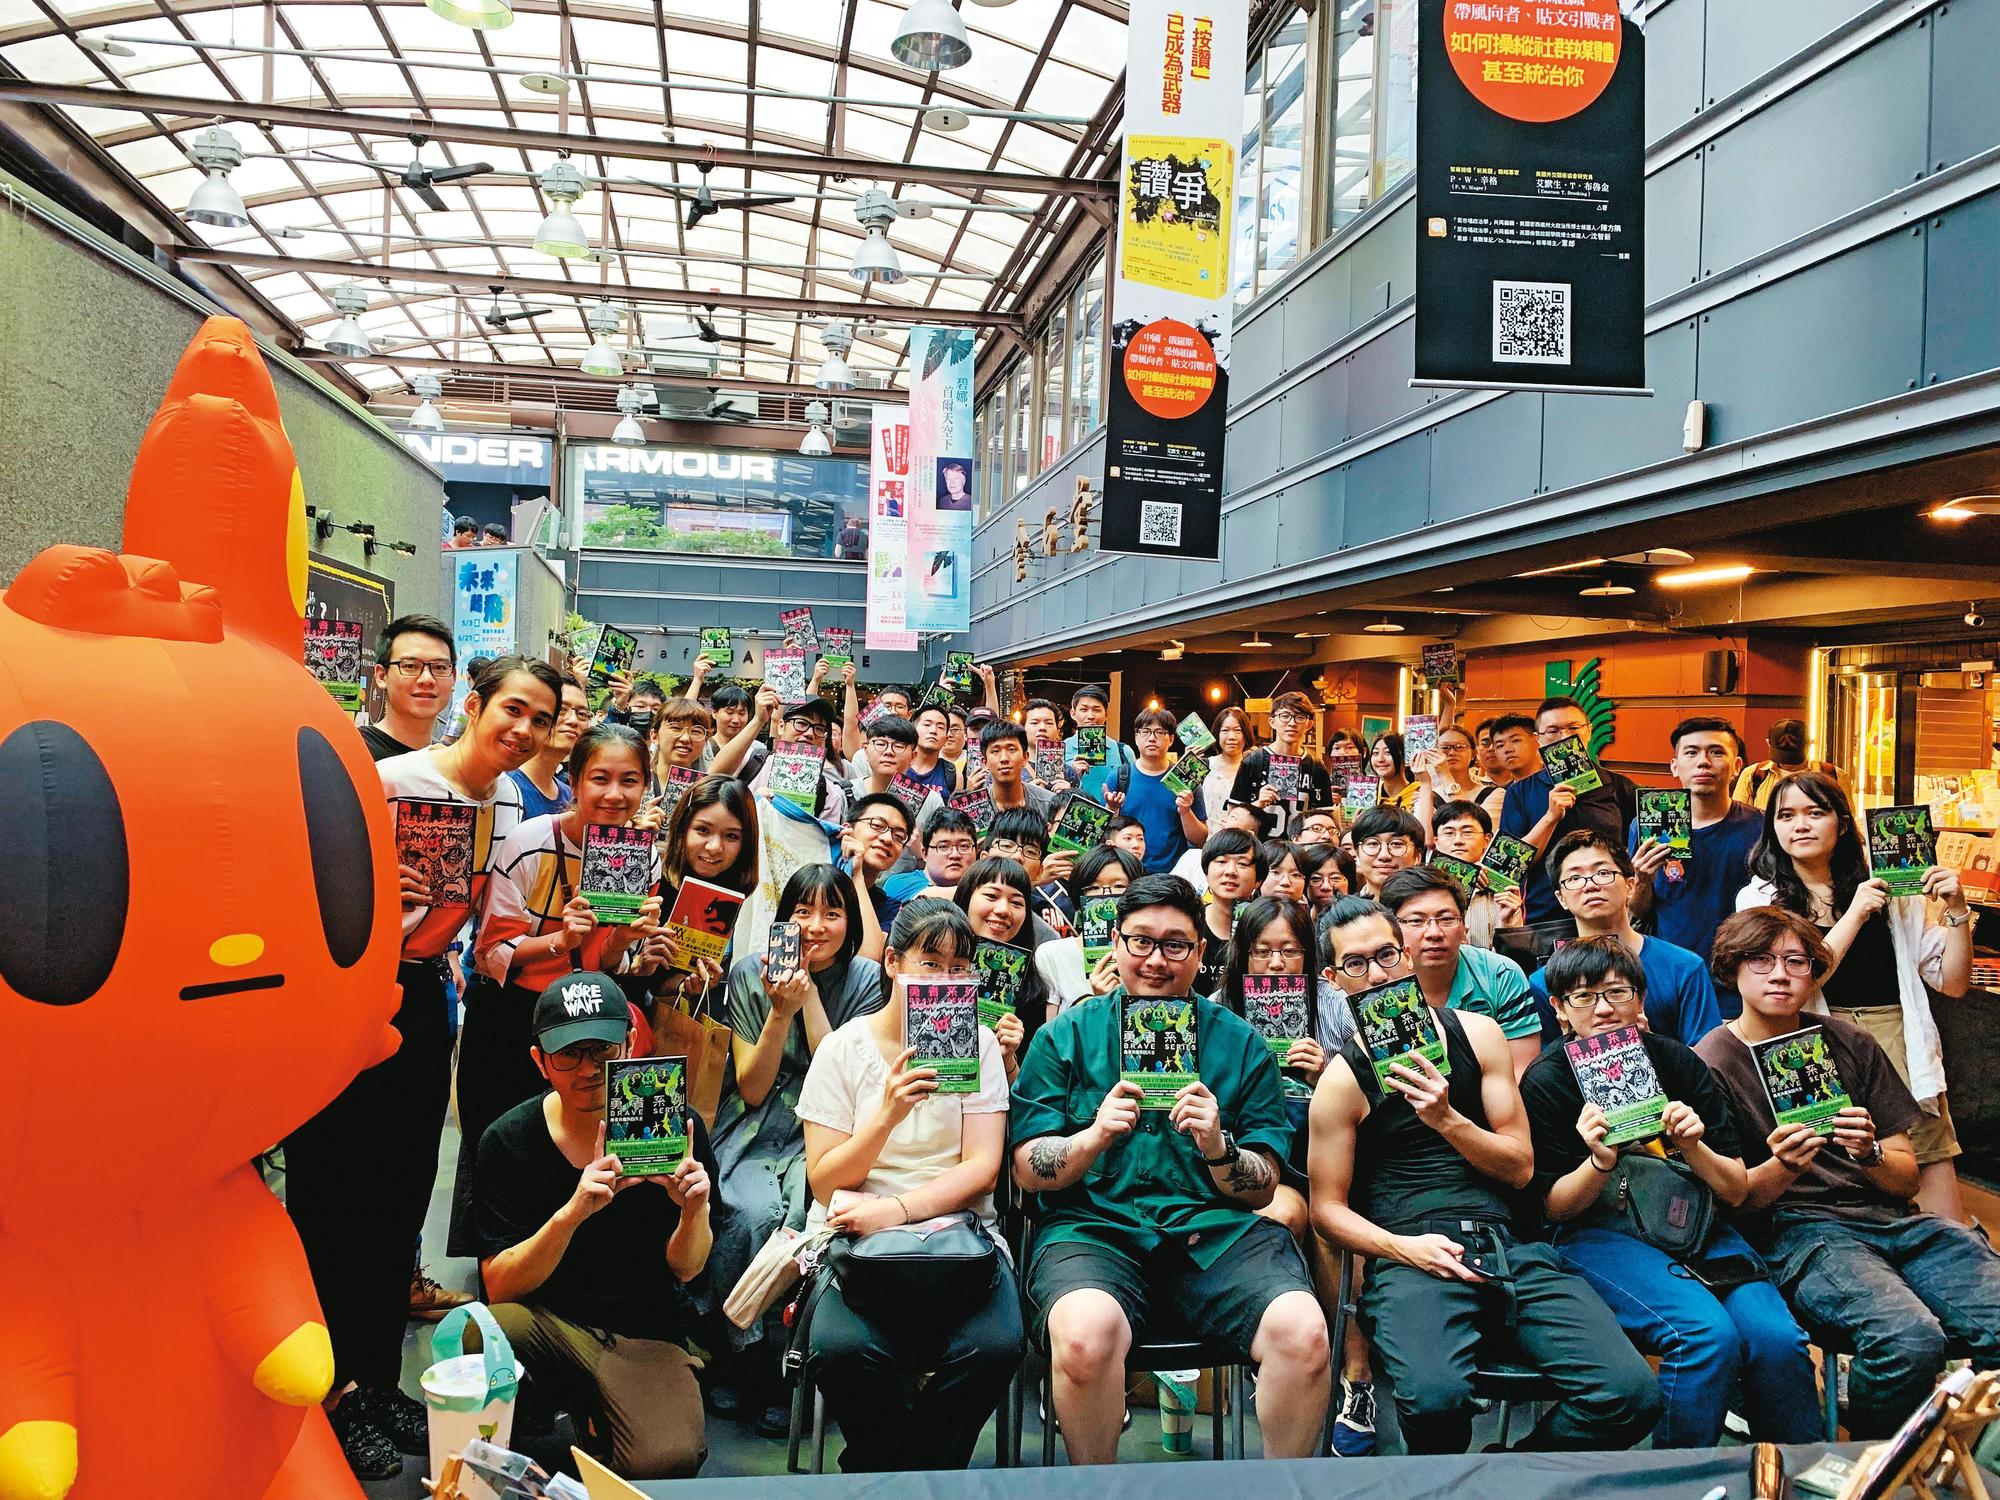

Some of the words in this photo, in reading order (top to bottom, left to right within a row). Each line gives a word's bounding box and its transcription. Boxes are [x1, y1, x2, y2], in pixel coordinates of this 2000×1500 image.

[1450, 31, 1615, 64] 如何操縱社群媒體
[1162, 13, 1185, 114] 已成為武器
[1482, 60, 1585, 87] 甚至統治你
[398, 433, 544, 468] NDER
[563, 998, 604, 1017] WANT
[1367, 1029, 1398, 1044] BRAVE
[1164, 1043, 1197, 1051] SERIES
[1770, 1081, 1802, 1094] BRAVE
[610, 1108, 644, 1117] BRAVE
[652, 1106, 685, 1115] SERIES
